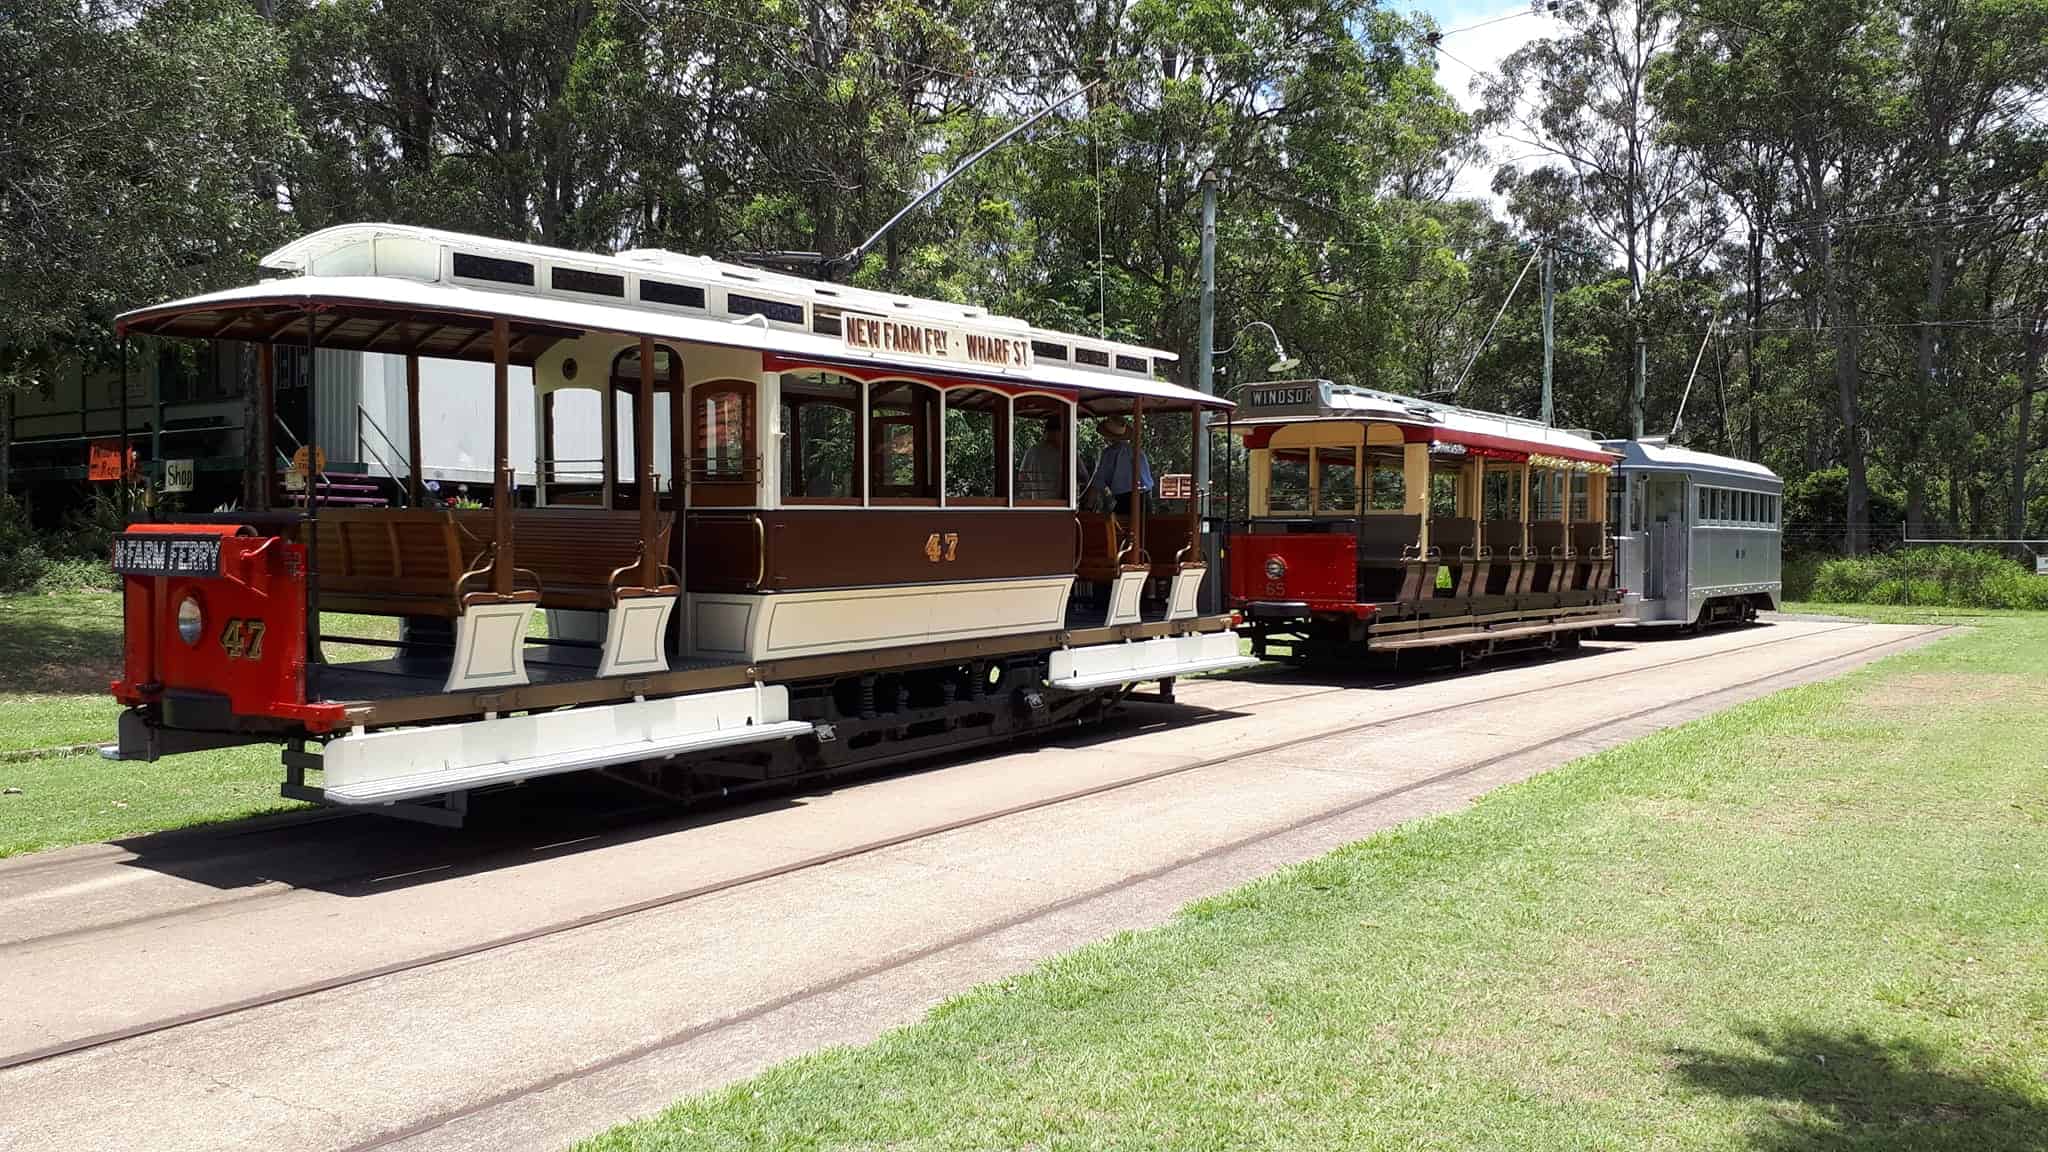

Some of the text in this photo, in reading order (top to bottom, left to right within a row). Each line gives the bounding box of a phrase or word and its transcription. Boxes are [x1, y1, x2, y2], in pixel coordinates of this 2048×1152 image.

[846, 316, 880, 349] NEW
[883, 321, 923, 354] FARM
[965, 333, 1010, 365] WHARF
[1013, 340, 1028, 367] ST
[1252, 388, 1313, 406] WINDSOR
[167, 464, 193, 489] Shop
[168, 540, 221, 571] FERRY
[924, 531, 960, 562] 47
[1265, 582, 1286, 597] 65
[221, 617, 266, 660] 47
